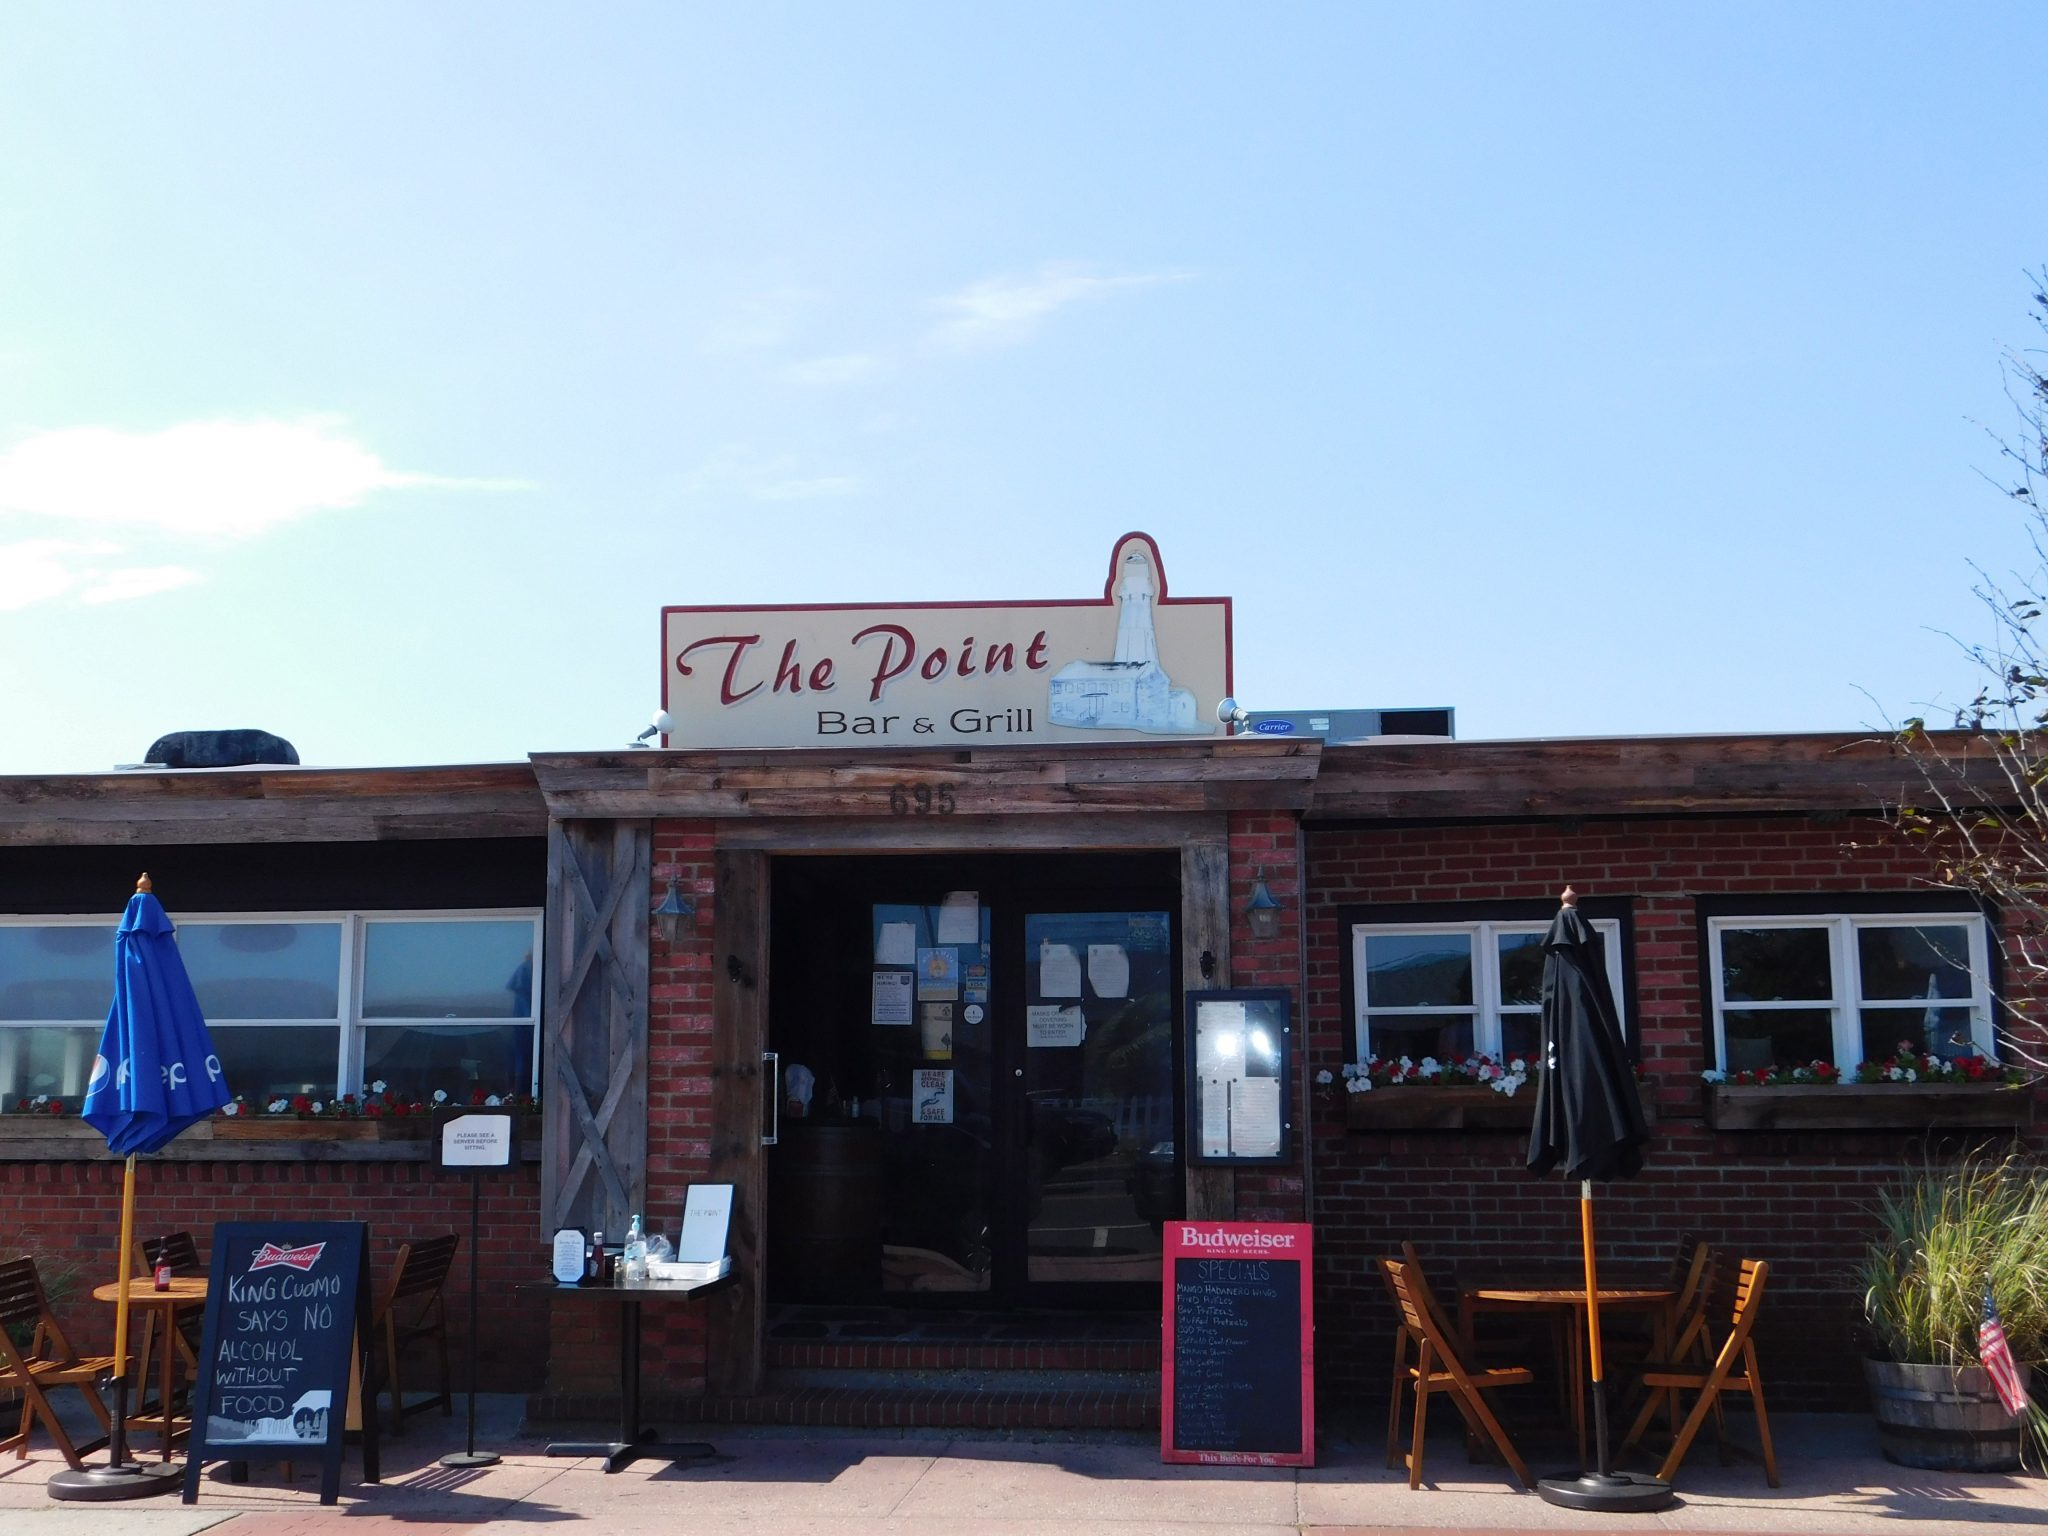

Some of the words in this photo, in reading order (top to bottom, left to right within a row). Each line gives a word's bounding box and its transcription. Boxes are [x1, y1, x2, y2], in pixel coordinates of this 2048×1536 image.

[676, 634, 836, 705] The
[852, 624, 1049, 703] Point
[817, 711, 900, 735] Bar
[912, 716, 935, 733] &
[949, 709, 1034, 733] Grill
[1259, 721, 1291, 732] Carrier
[890, 782, 956, 816] 695
[1180, 1227, 1295, 1249] Budweiser
[251, 1249, 321, 1263] Budweiser
[1198, 1259, 1271, 1281] SPECIALS
[229, 1275, 277, 1303] KING
[237, 1309, 289, 1332] SAYS
[304, 1303, 332, 1331] NO
[218, 1338, 304, 1362] ALCOHOL
[216, 1366, 299, 1385] WITHOUT
[220, 1395, 285, 1415] FOOD
[1198, 1453, 1218, 1462] This
[1242, 1454, 1258, 1463] For
